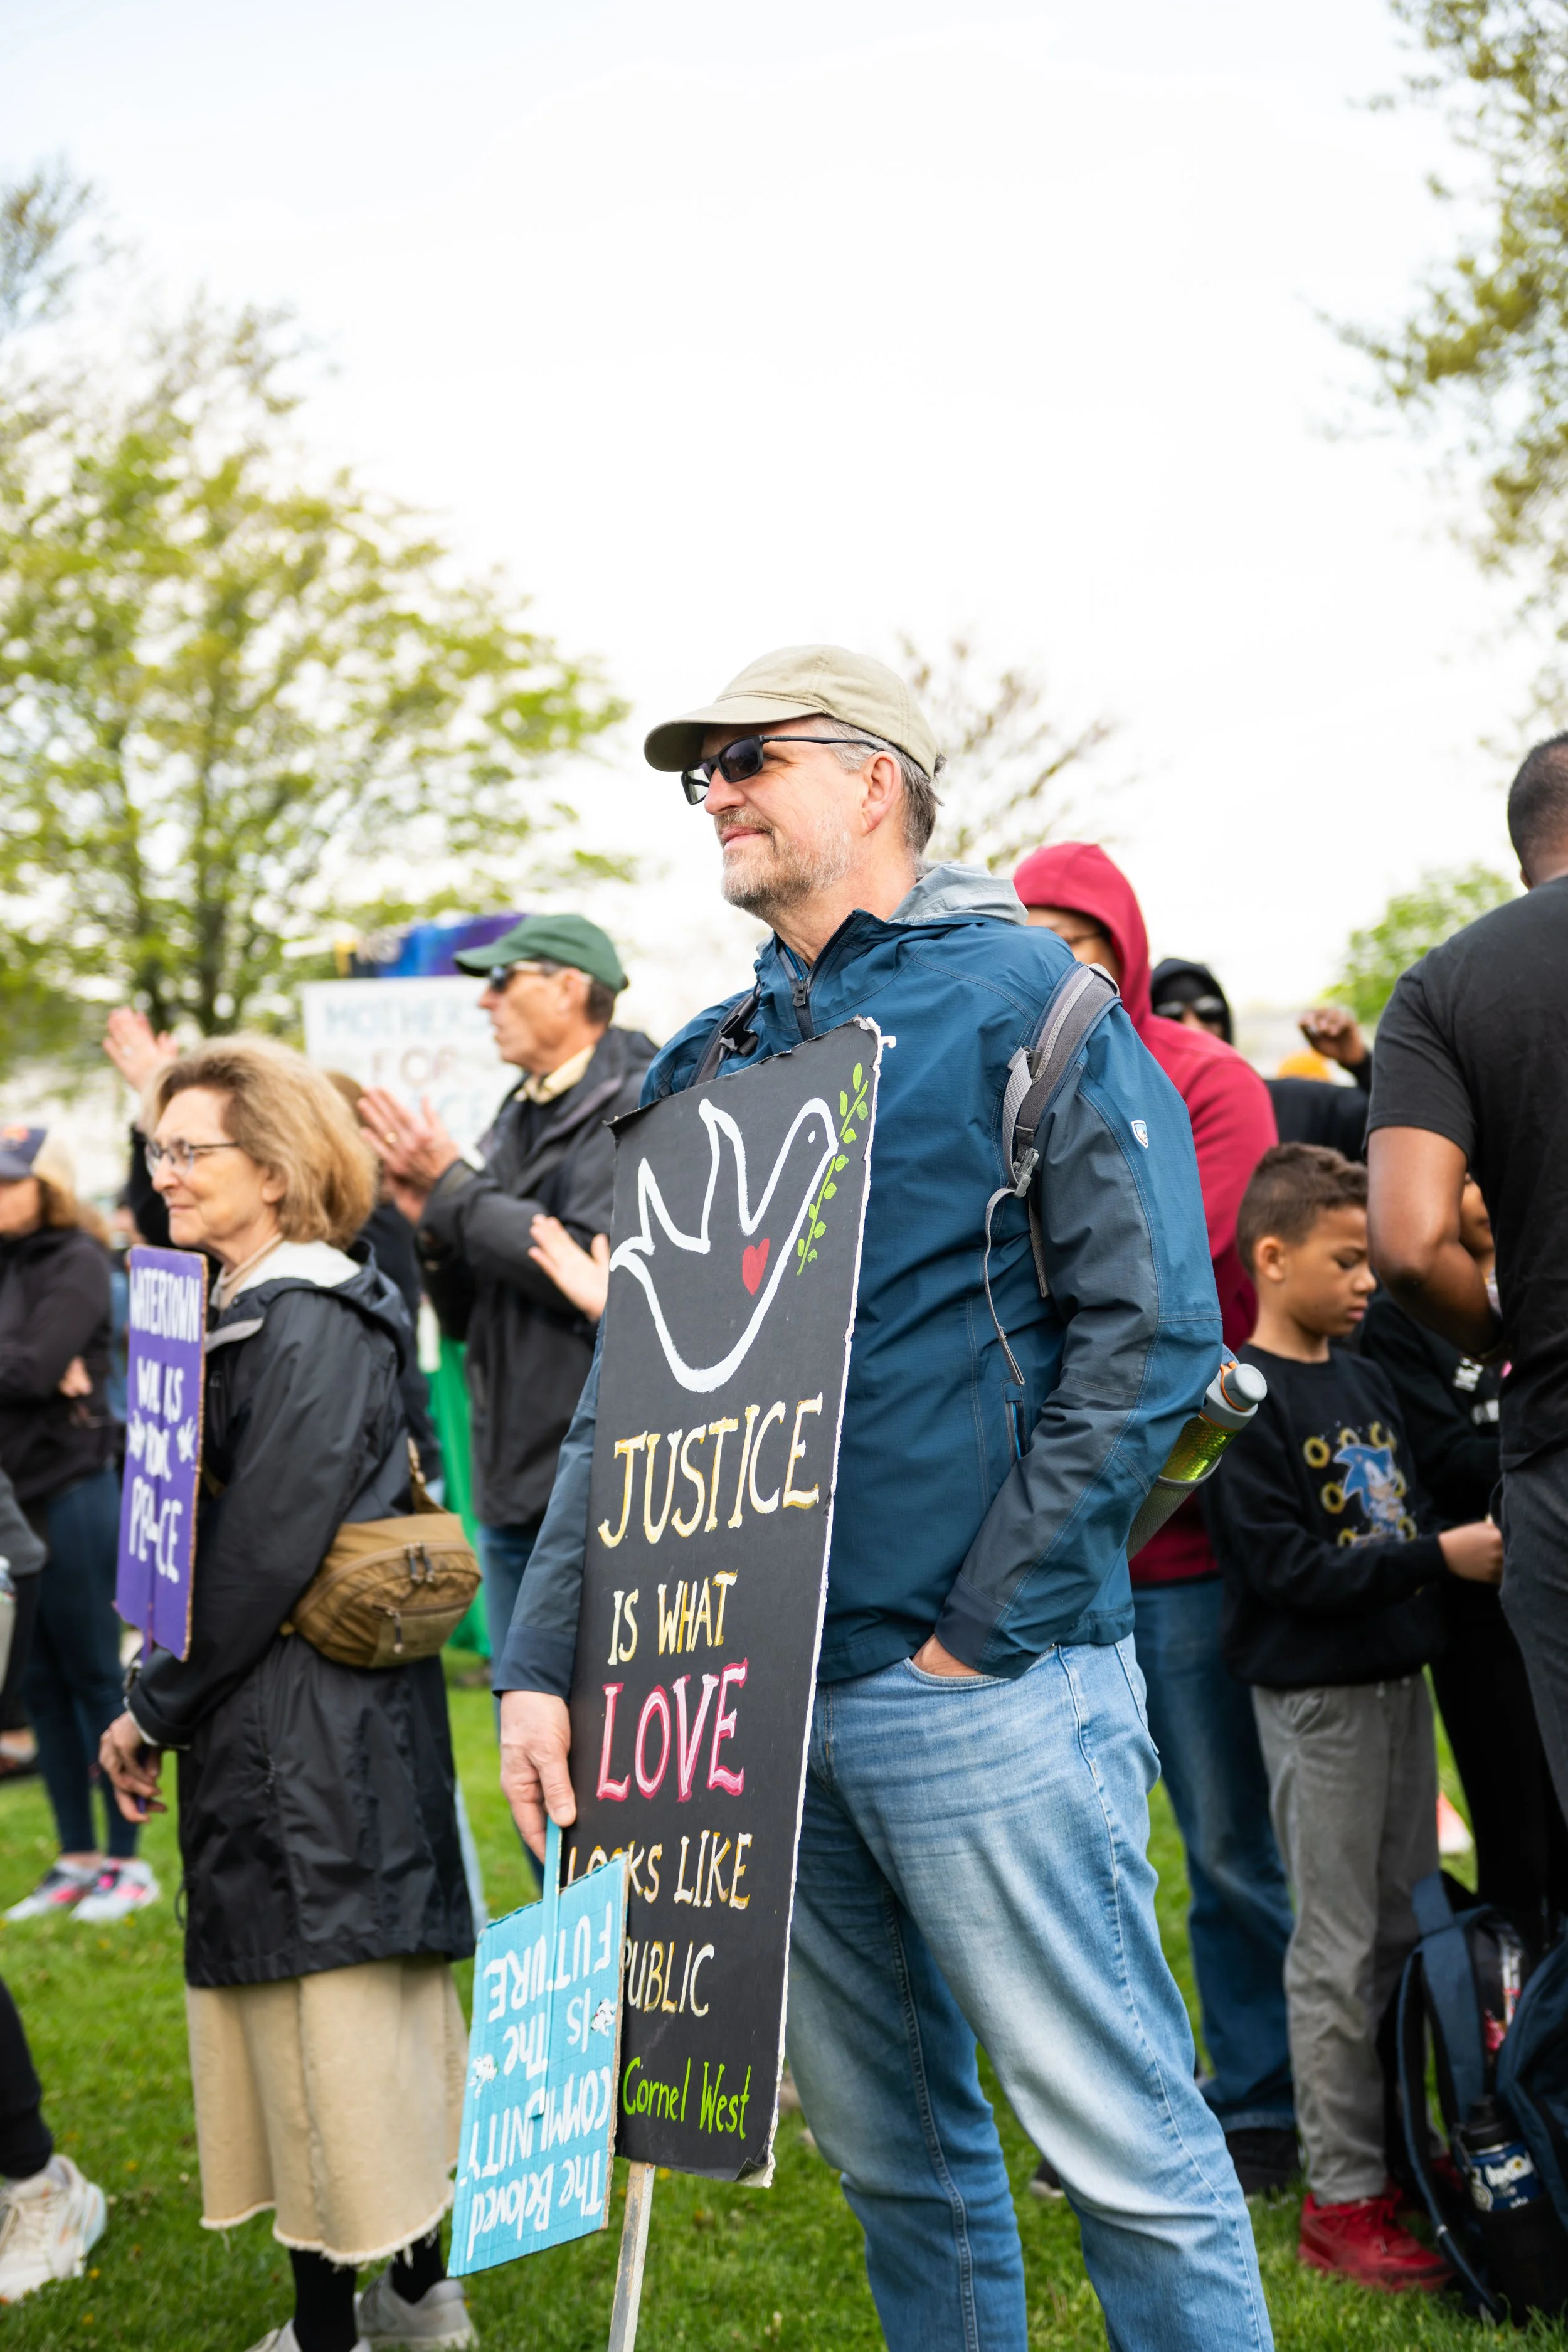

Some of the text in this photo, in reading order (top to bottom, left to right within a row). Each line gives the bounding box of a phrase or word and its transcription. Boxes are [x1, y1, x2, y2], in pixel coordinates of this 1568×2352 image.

[129, 1266, 201, 1343] WATERTOWN
[598, 1392, 824, 1549] JUSTICE
[129, 1475, 183, 1584] PEACE
[607, 1568, 739, 1666] IS WHAT
[596, 1656, 750, 1803] LOVE
[567, 1829, 753, 1910] LKS LIKE
[482, 1900, 612, 2023] FUTURE
[502, 2011, 548, 2081] The
[623, 2056, 751, 2141] Cornel West
[458, 2065, 613, 2188] COMMUNITY
[466, 2149, 603, 2262] The Beloved
